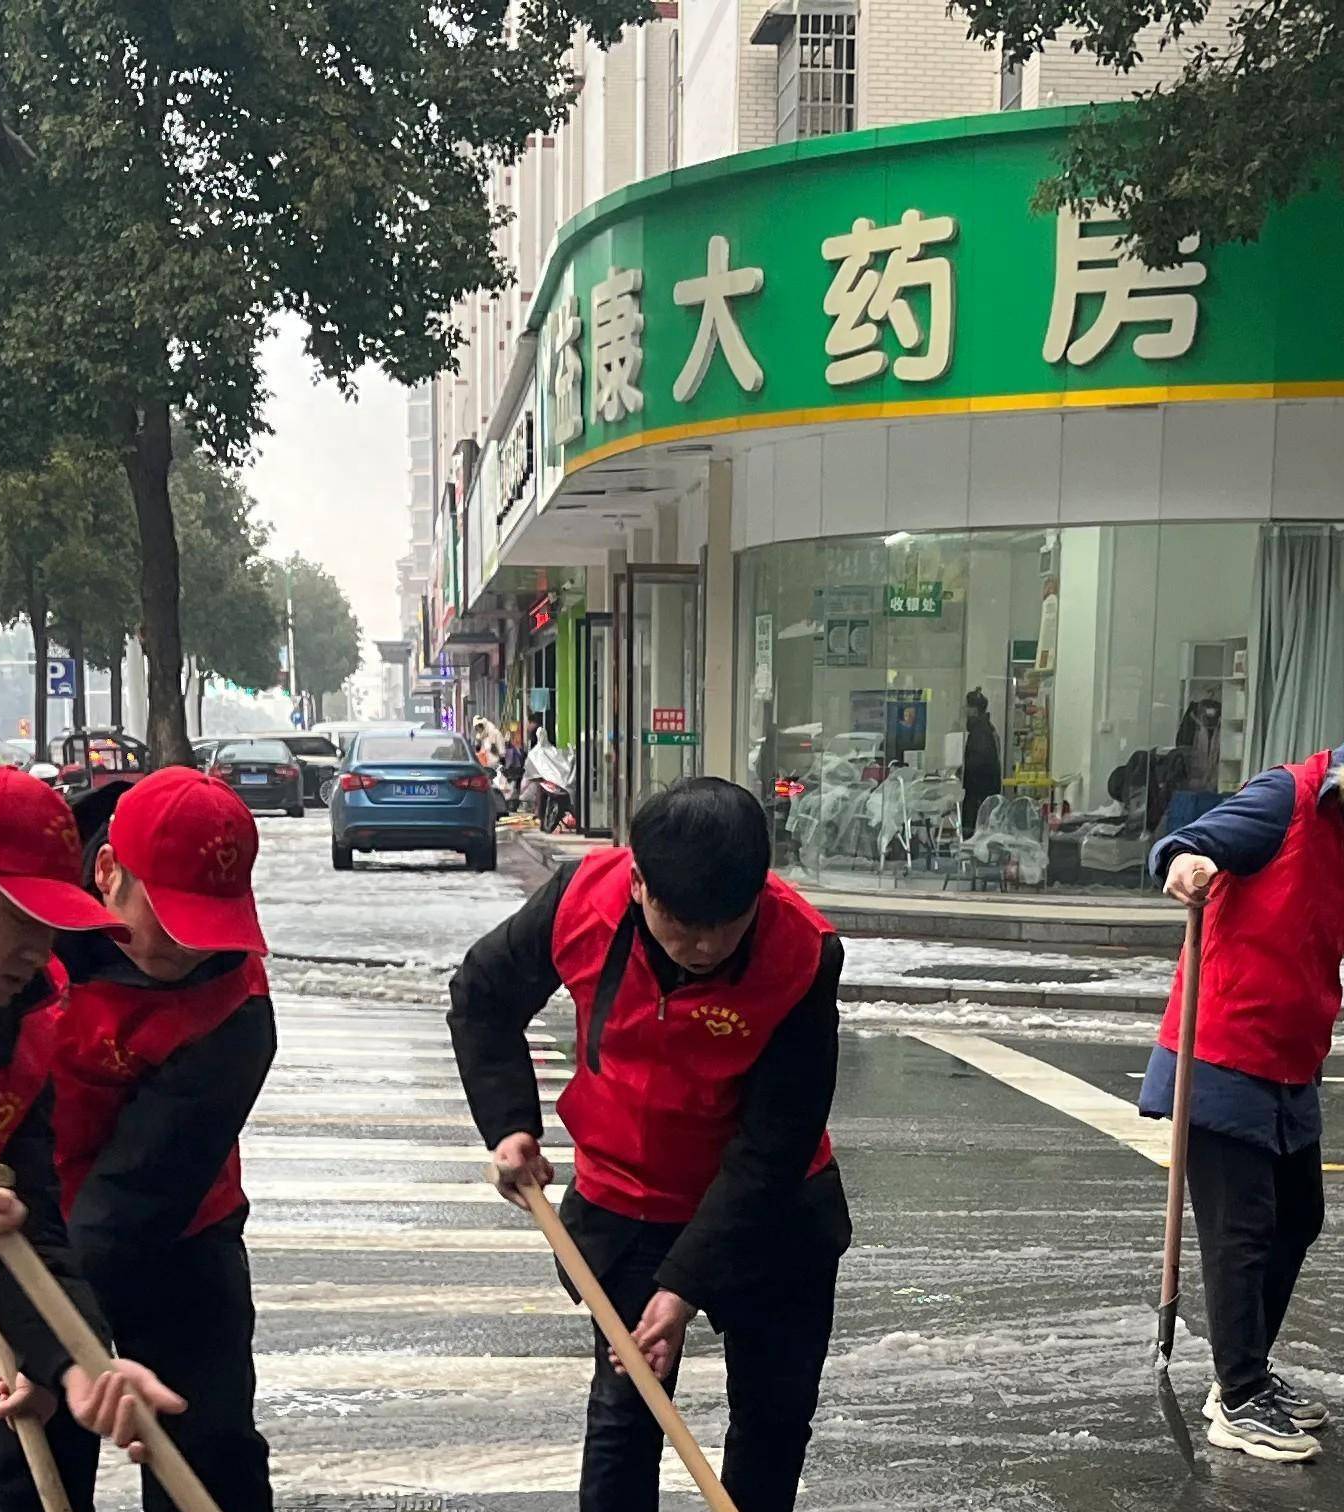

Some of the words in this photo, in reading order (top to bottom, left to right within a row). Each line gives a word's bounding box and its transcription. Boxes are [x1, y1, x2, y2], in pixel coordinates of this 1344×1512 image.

[890, 597, 936, 612] 收银处
[47, 661, 66, 694] P
